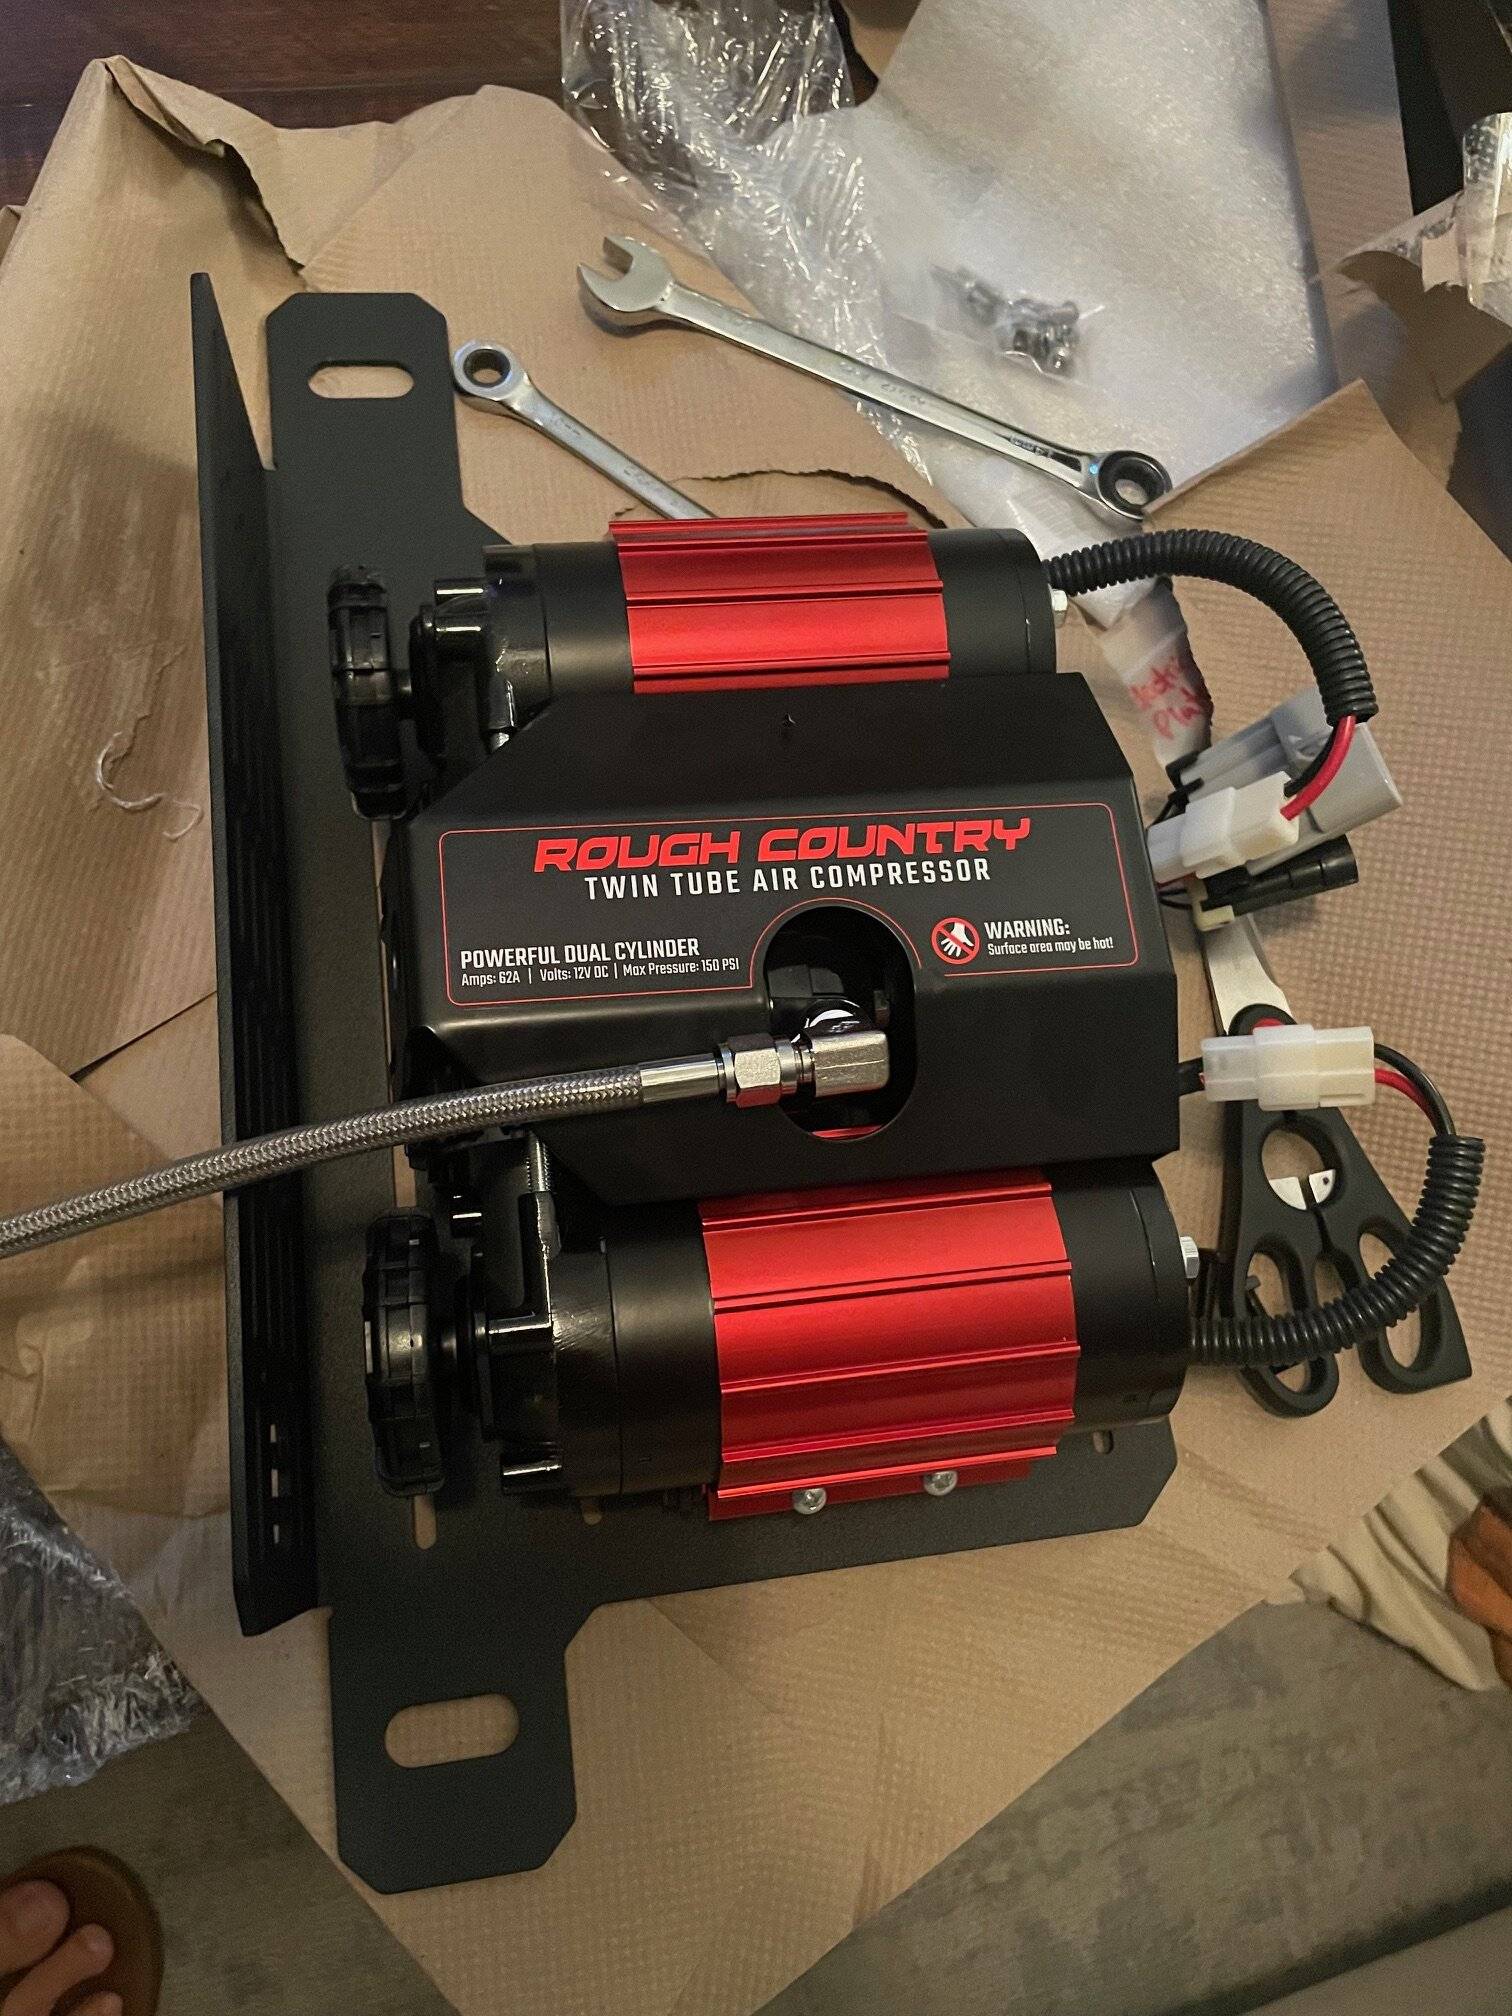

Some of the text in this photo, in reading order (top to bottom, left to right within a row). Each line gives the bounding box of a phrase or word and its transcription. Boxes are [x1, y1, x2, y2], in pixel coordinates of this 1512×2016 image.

[534, 817, 1031, 873] ROUGH COUNTRY
[584, 857, 991, 900] TWIN TUBE AIR COMPRESSOR
[984, 918, 1070, 939] WARNING:
[461, 937, 700, 969] POWERFUL DUAL CYLINDER
[987, 936, 1114, 956] Surface area may be hot!
[461, 972, 497, 986] Amps:
[499, 971, 521, 984] 62A
[540, 967, 571, 982] Volts:
[573, 966, 592, 980] 12V
[594, 965, 609, 979] DC
[623, 963, 647, 977] Max
[648, 960, 700, 975] Pressure:
[701, 959, 720, 972] 150
[722, 958, 740, 971] PSI
